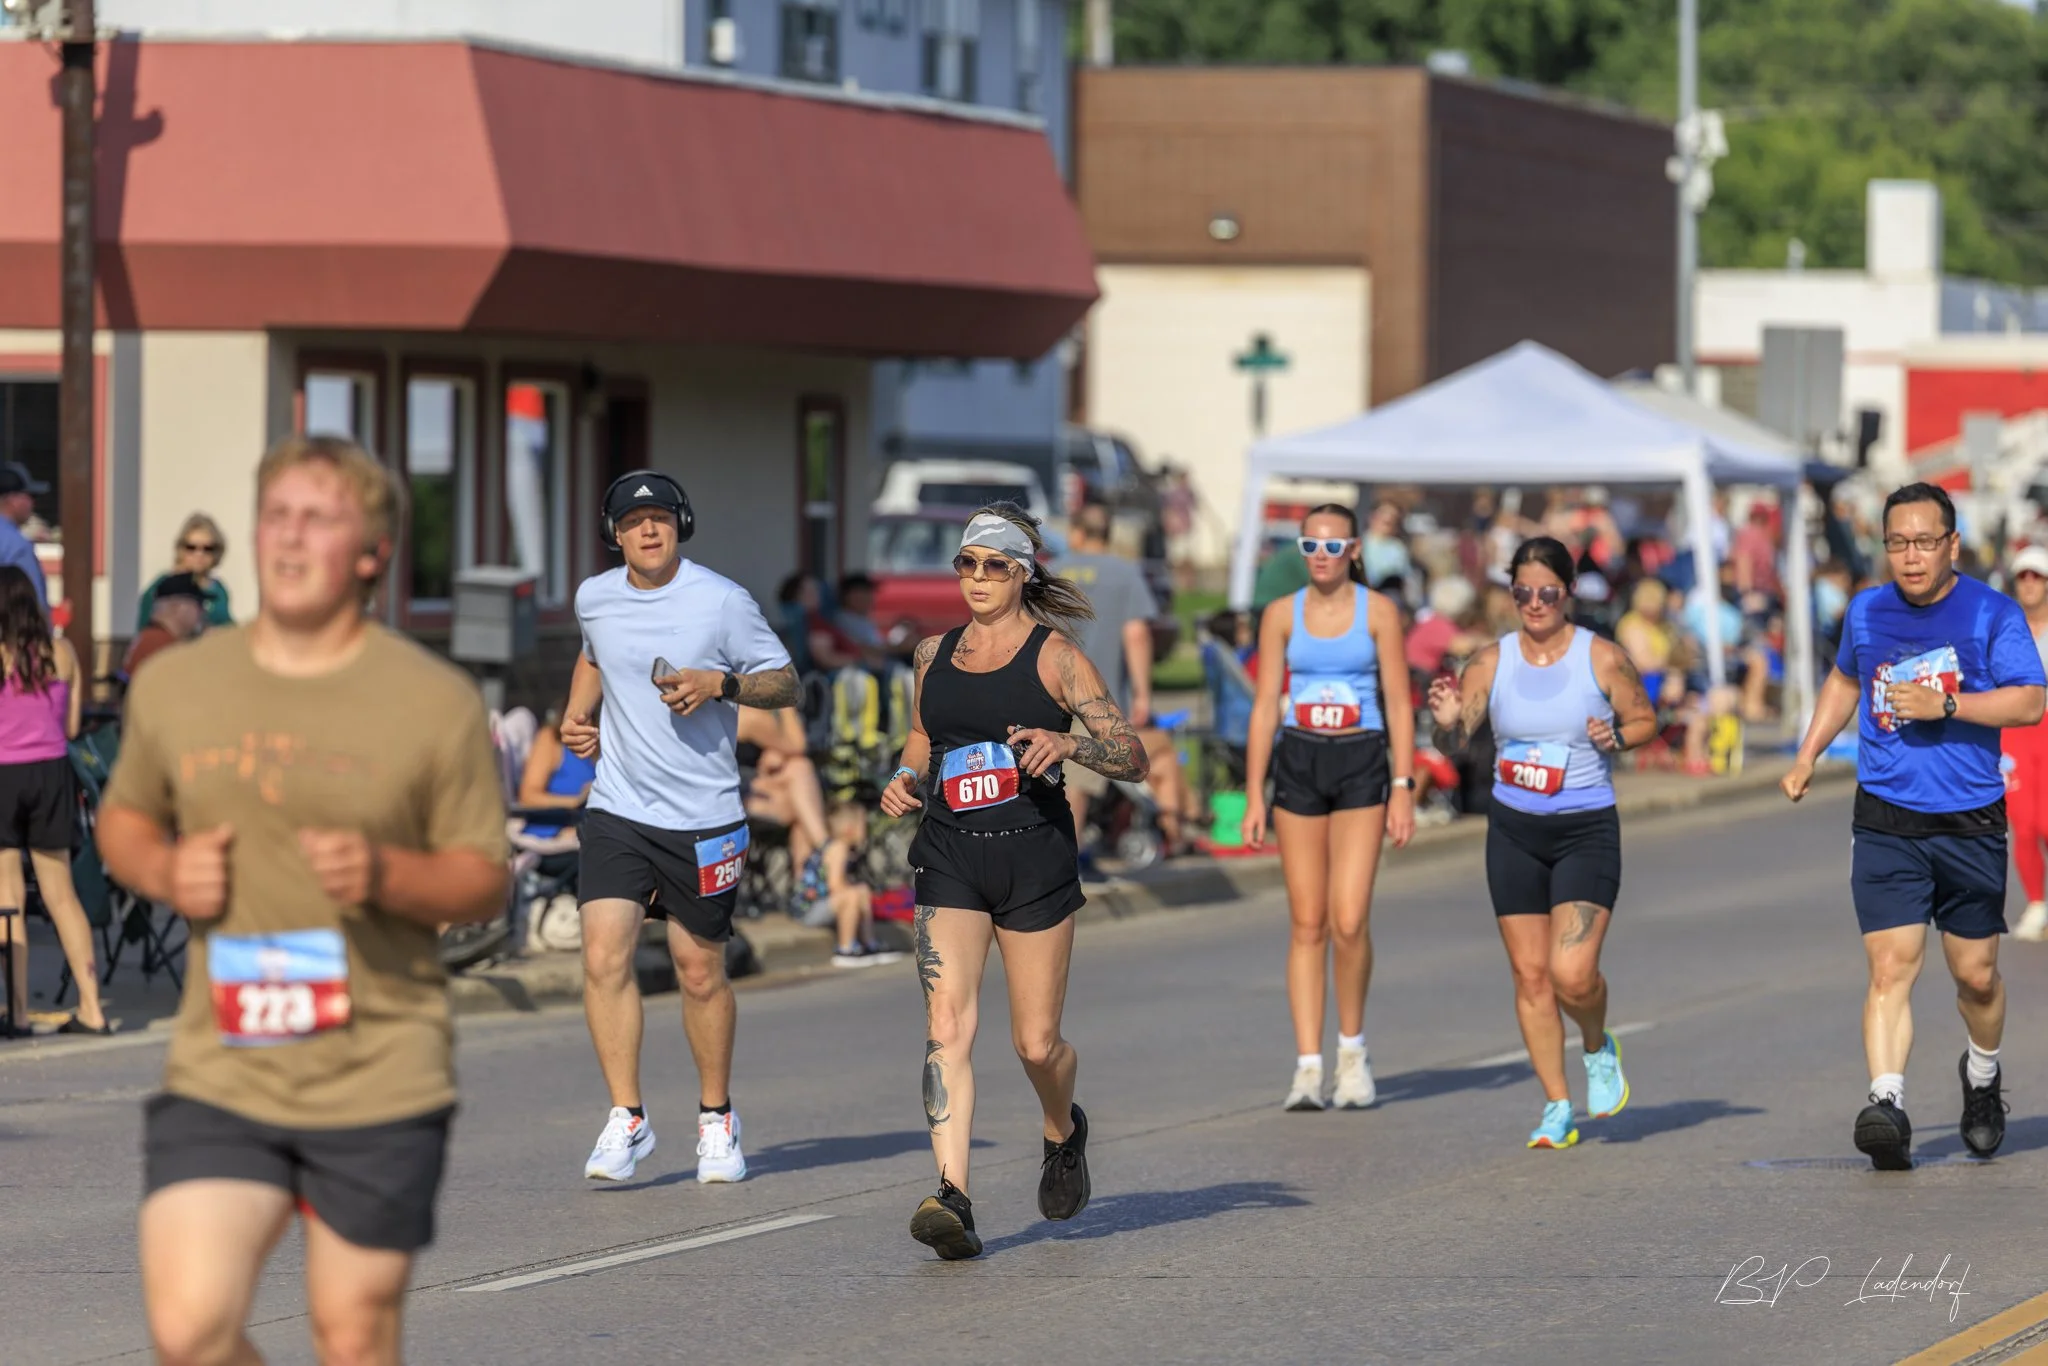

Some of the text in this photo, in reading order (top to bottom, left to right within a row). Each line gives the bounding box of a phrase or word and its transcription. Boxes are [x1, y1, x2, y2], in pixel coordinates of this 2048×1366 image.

[1310, 705, 1345, 728] 647
[959, 774, 1000, 804] 670
[1512, 763, 1549, 791] 200
[714, 857, 742, 888] 250
